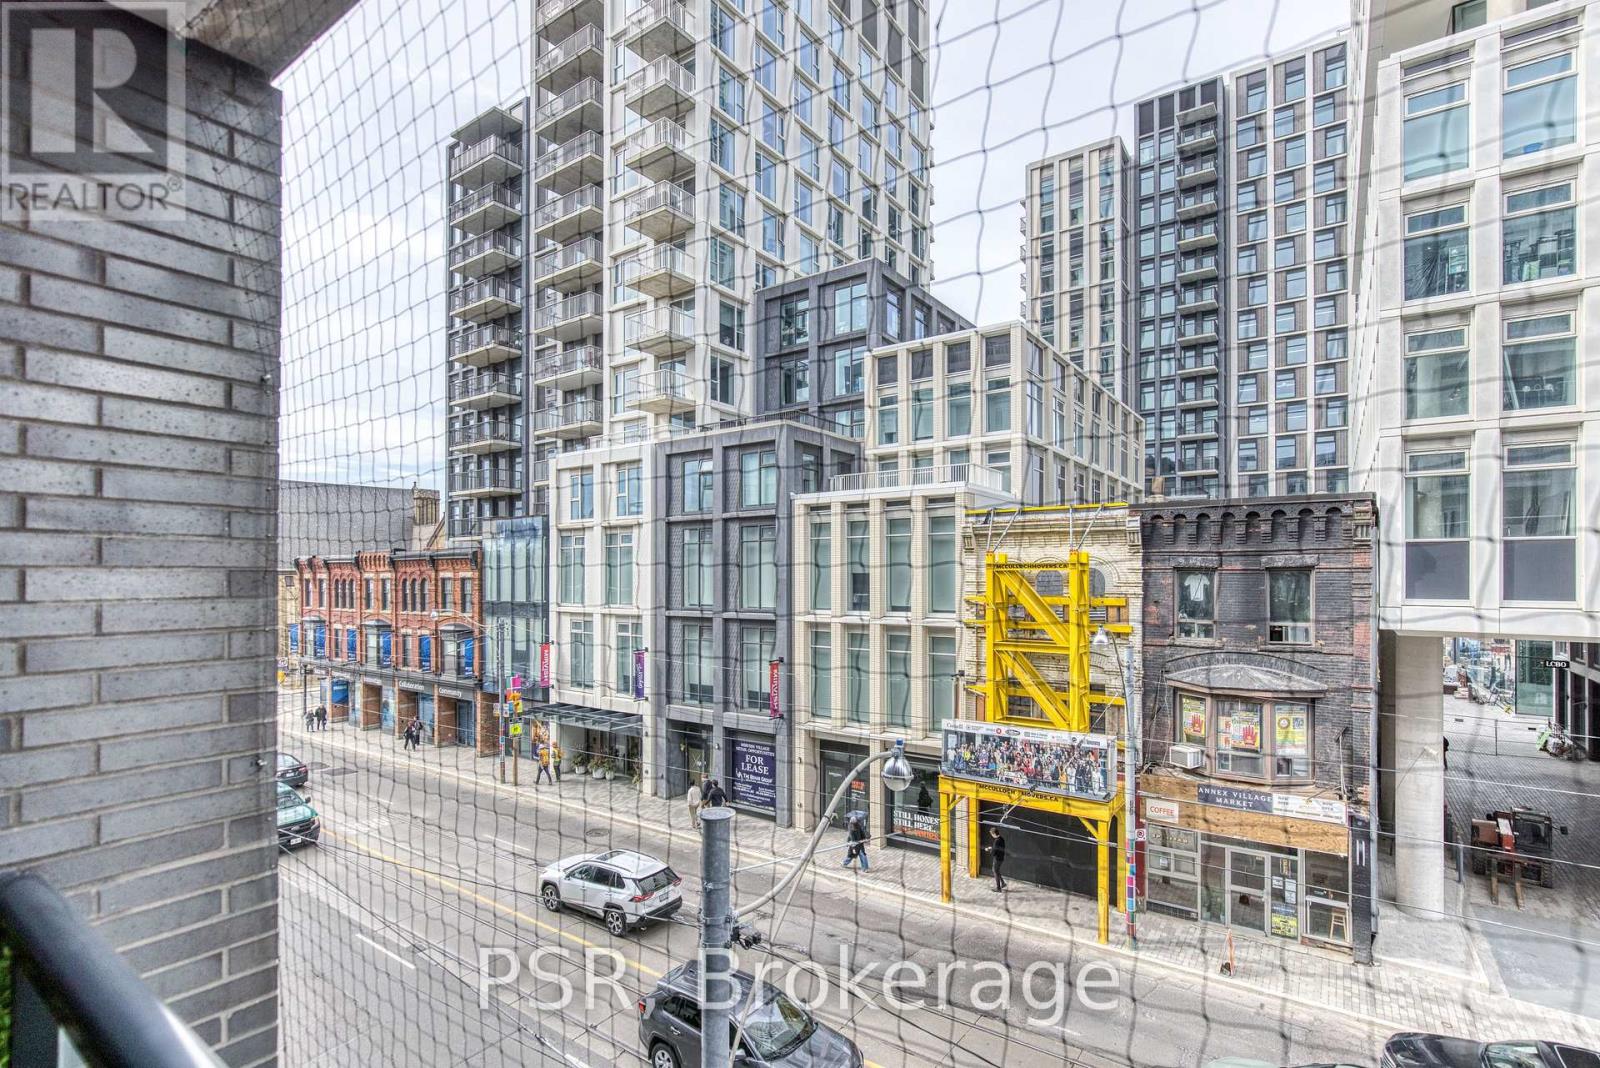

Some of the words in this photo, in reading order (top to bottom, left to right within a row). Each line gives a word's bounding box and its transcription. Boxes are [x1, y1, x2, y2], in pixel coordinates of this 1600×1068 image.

[745, 754, 764, 765] FOR
[741, 762, 769, 775] LEASE
[1198, 787, 1229, 797] ANNEX
[1232, 790, 1272, 802] VILLAGE
[1215, 797, 1254, 808] MARKET
[1149, 805, 1175, 817] COFFEE
